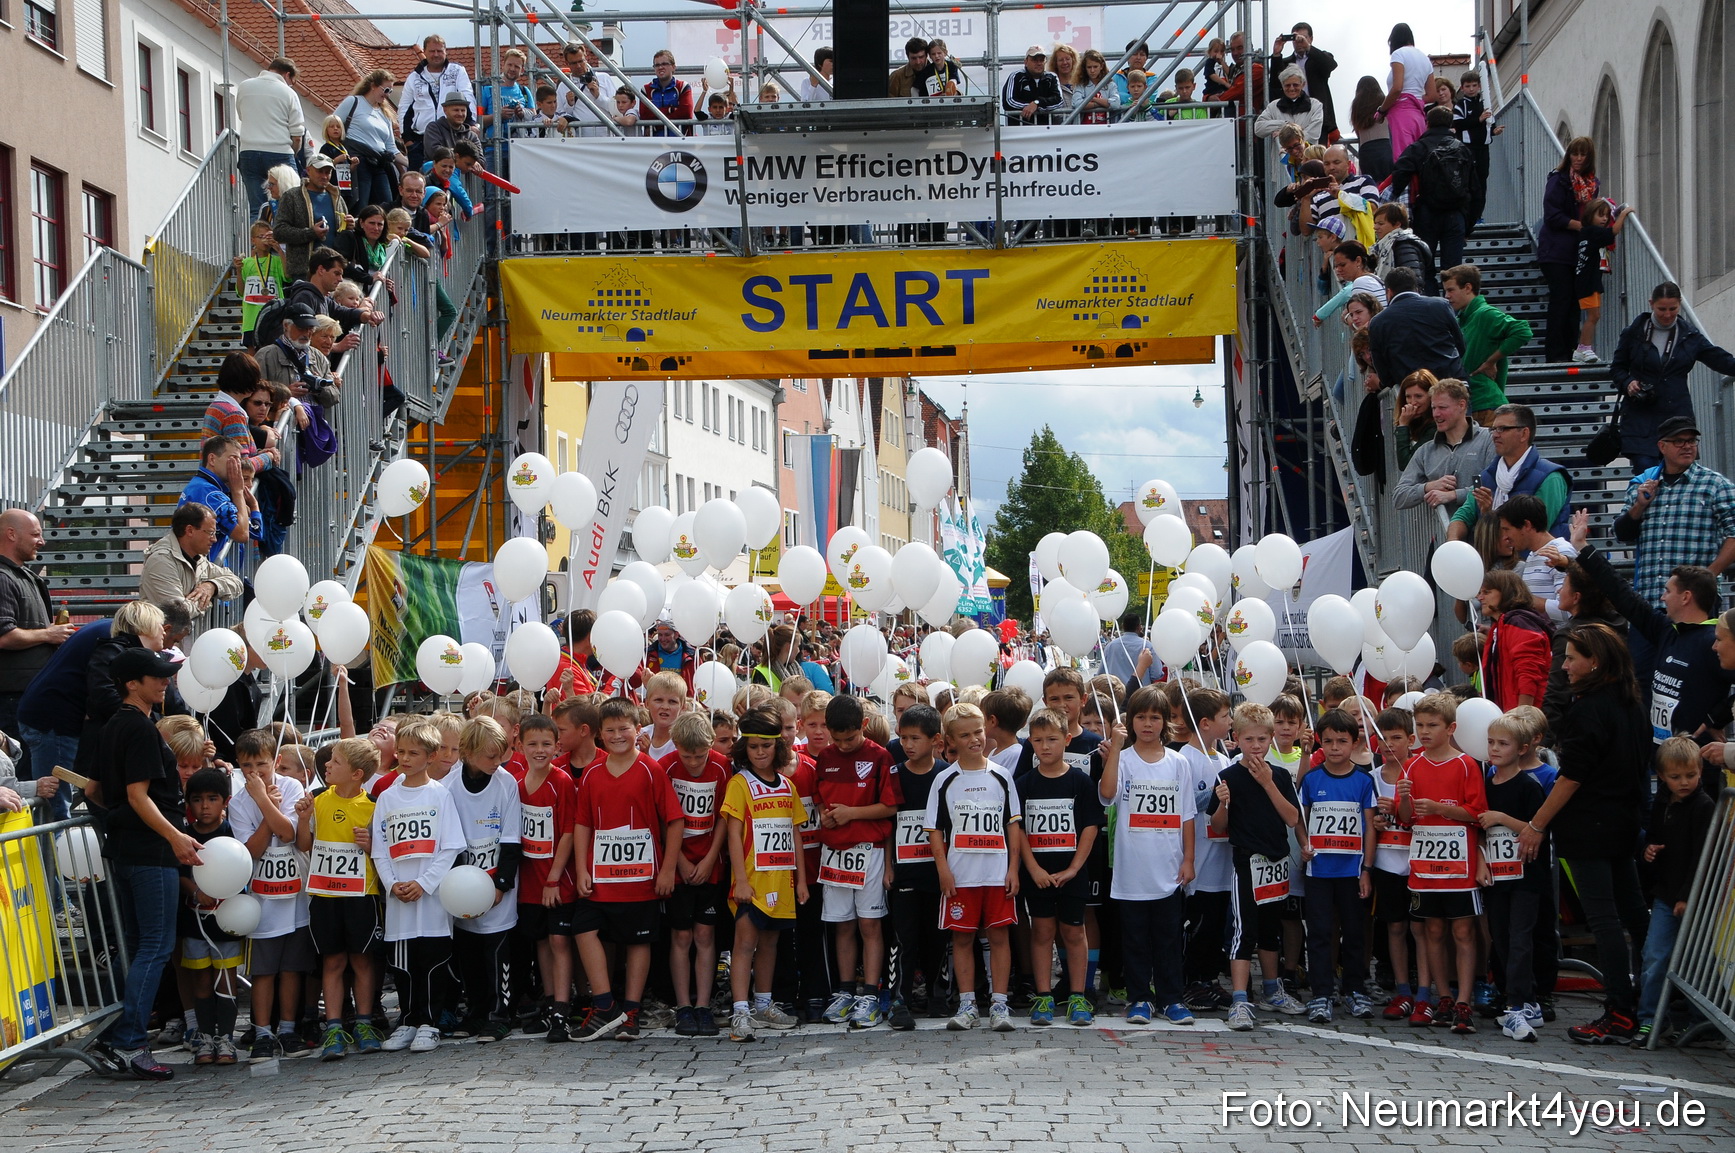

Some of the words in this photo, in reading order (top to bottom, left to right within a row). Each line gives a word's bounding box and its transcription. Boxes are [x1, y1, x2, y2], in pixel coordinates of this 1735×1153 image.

[723, 155, 806, 183] BMW
[815, 148, 1099, 181] EfficientDynamics
[725, 188, 809, 208] Weniger
[812, 184, 922, 204] Verbrauch.
[928, 181, 980, 199] Mehr
[986, 179, 1101, 198] Fahrfreude.
[249, 283, 275, 295] 715
[741, 268, 990, 332] START
[1036, 295, 1122, 310] Neumarkter
[1126, 293, 1194, 308] Stadtlauf
[541, 308, 627, 321] Neumarkter
[631, 308, 697, 321] Stadtlauf
[582, 521, 605, 590] Audi
[597, 459, 619, 517] BKK
[678, 792, 714, 815] 7092
[753, 801, 775, 812] MAX
[1135, 794, 1175, 814] 7391
[400, 810, 428, 818] Neumarkt
[960, 812, 1000, 833] 7108
[1028, 813, 1071, 833] 7205
[522, 816, 545, 838] 091
[1316, 815, 1358, 835] 7242
[313, 845, 328, 853] PARTL
[328, 847, 357, 855] Neumarkt
[760, 831, 792, 852] 7283
[968, 837, 994, 847] Fabian
[1037, 836, 1061, 846] Robin
[1324, 837, 1349, 848] Marco
[1415, 840, 1460, 860] 7228
[600, 842, 646, 862] 7097
[826, 847, 866, 871] 7166
[258, 858, 297, 879] 7086
[317, 853, 360, 876] 7124
[609, 866, 638, 876] Lorenz
[1256, 861, 1289, 886] 7388
[263, 884, 288, 893] David
[327, 880, 341, 889] Jan
